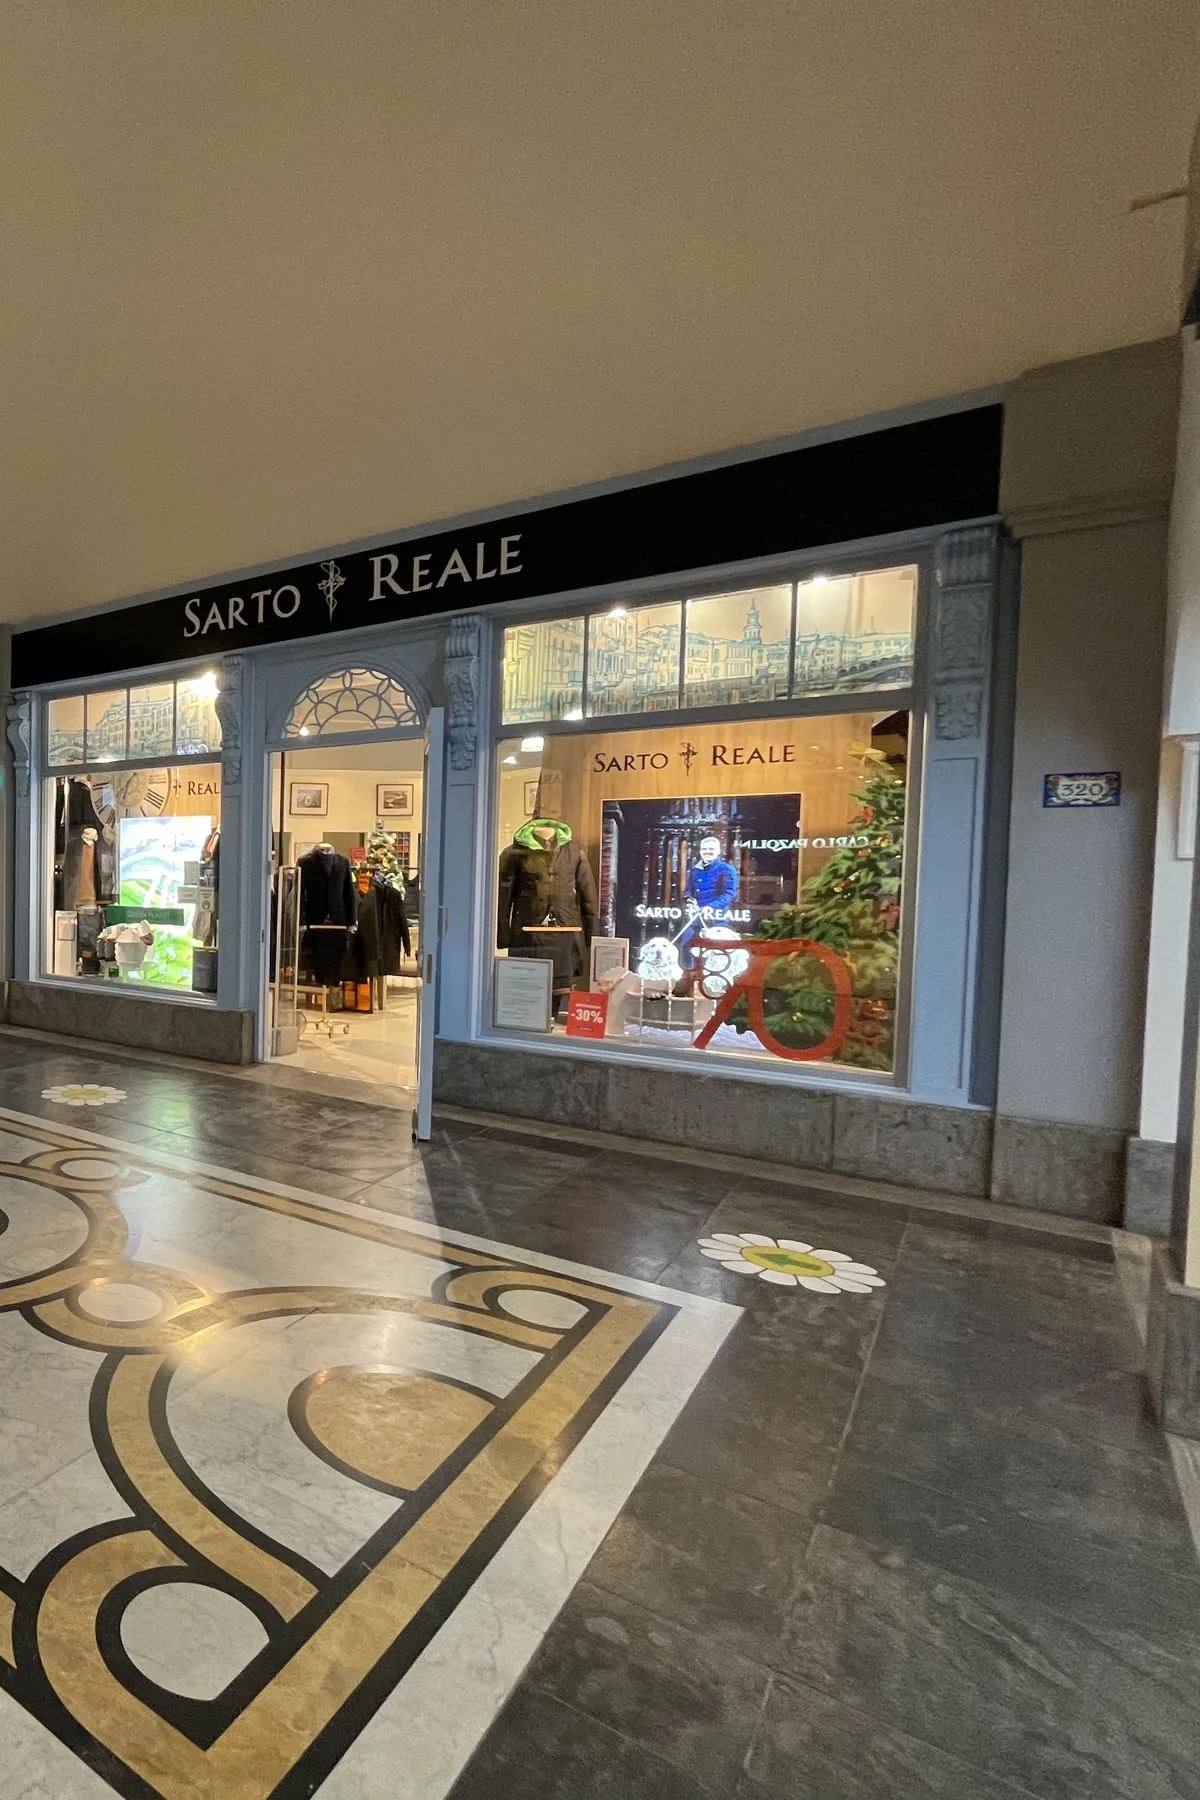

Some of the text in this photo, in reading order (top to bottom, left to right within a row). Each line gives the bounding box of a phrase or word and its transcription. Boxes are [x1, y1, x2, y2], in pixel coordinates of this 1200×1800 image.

[183, 534, 523, 638] SARTO REALE
[593, 744, 796, 773] SARTO REALE
[1061, 782, 1104, 797] 320
[636, 904, 751, 922] SARTO REALE
[570, 1008, 604, 1024] -30%
